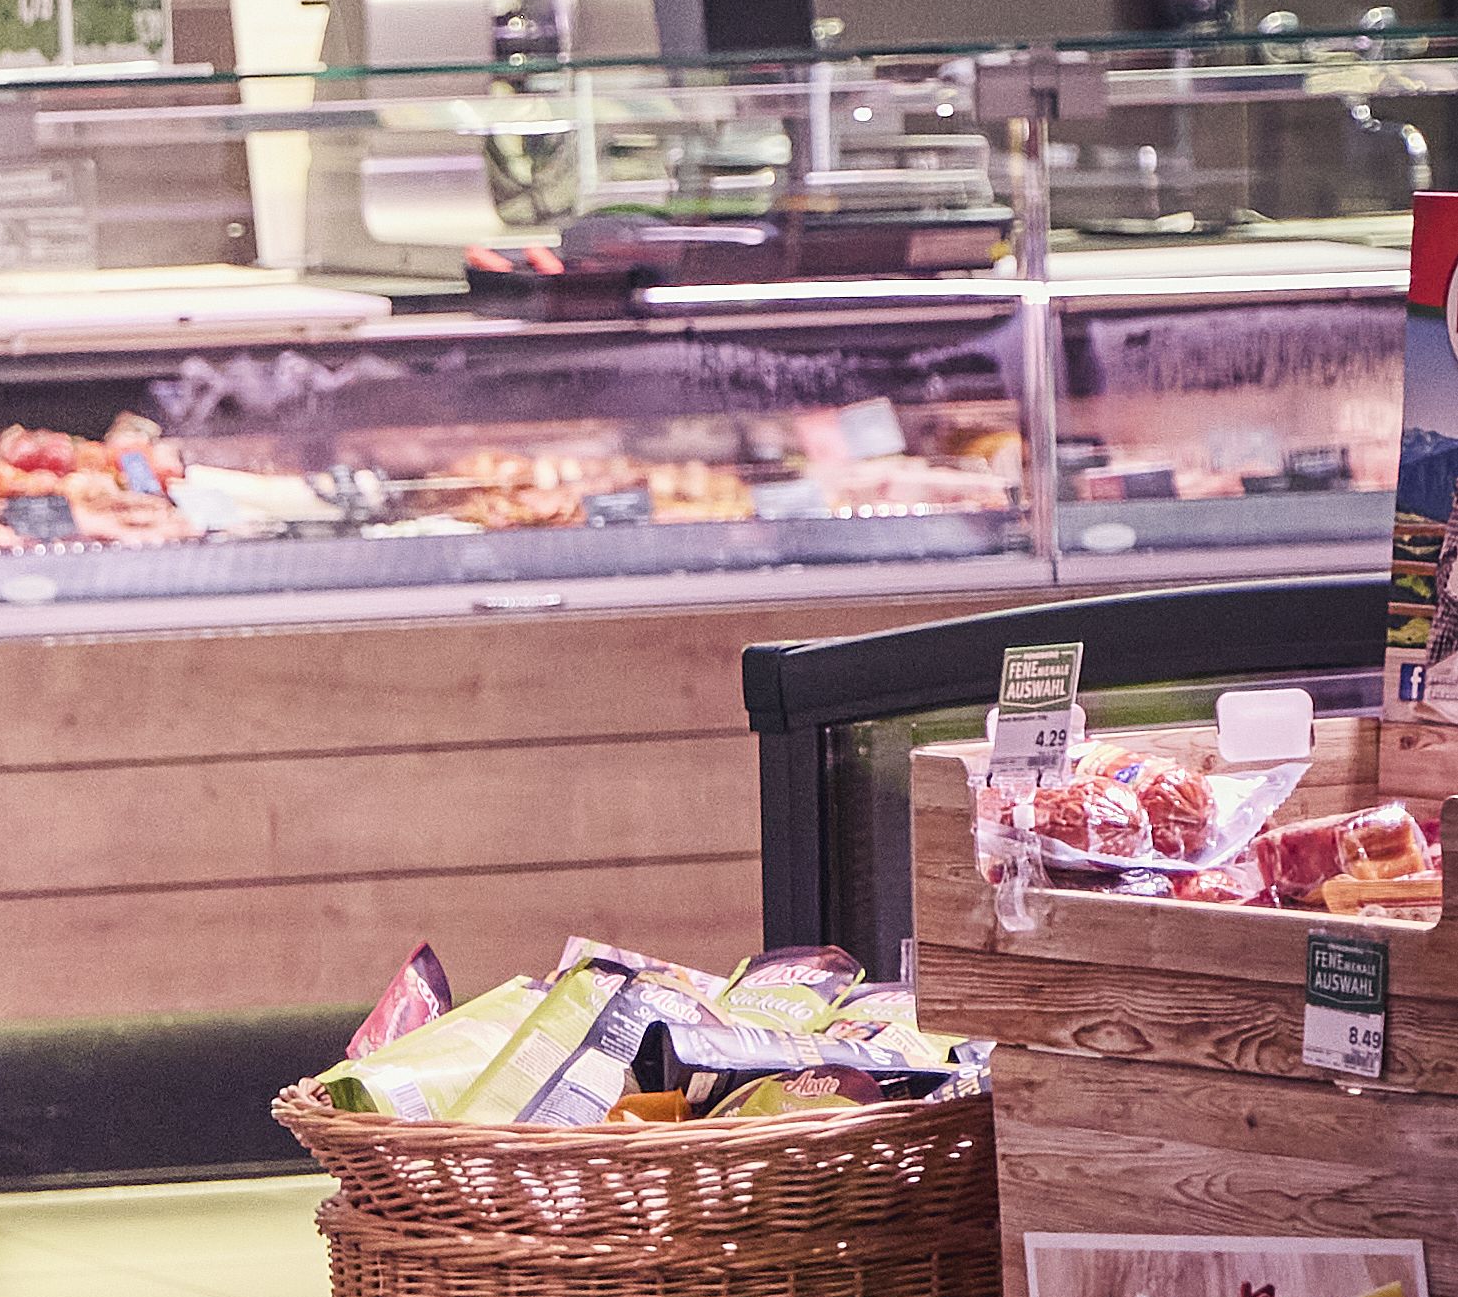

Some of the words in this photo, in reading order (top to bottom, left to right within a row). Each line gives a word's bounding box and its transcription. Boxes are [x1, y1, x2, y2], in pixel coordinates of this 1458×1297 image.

[1006, 679, 1066, 700] AUSWAHL
[1036, 729, 1066, 747] 4.29
[1315, 972, 1374, 997] AUSWAHL
[1348, 1026, 1382, 1049] 8.49
[783, 1070, 840, 1098] Aoste
